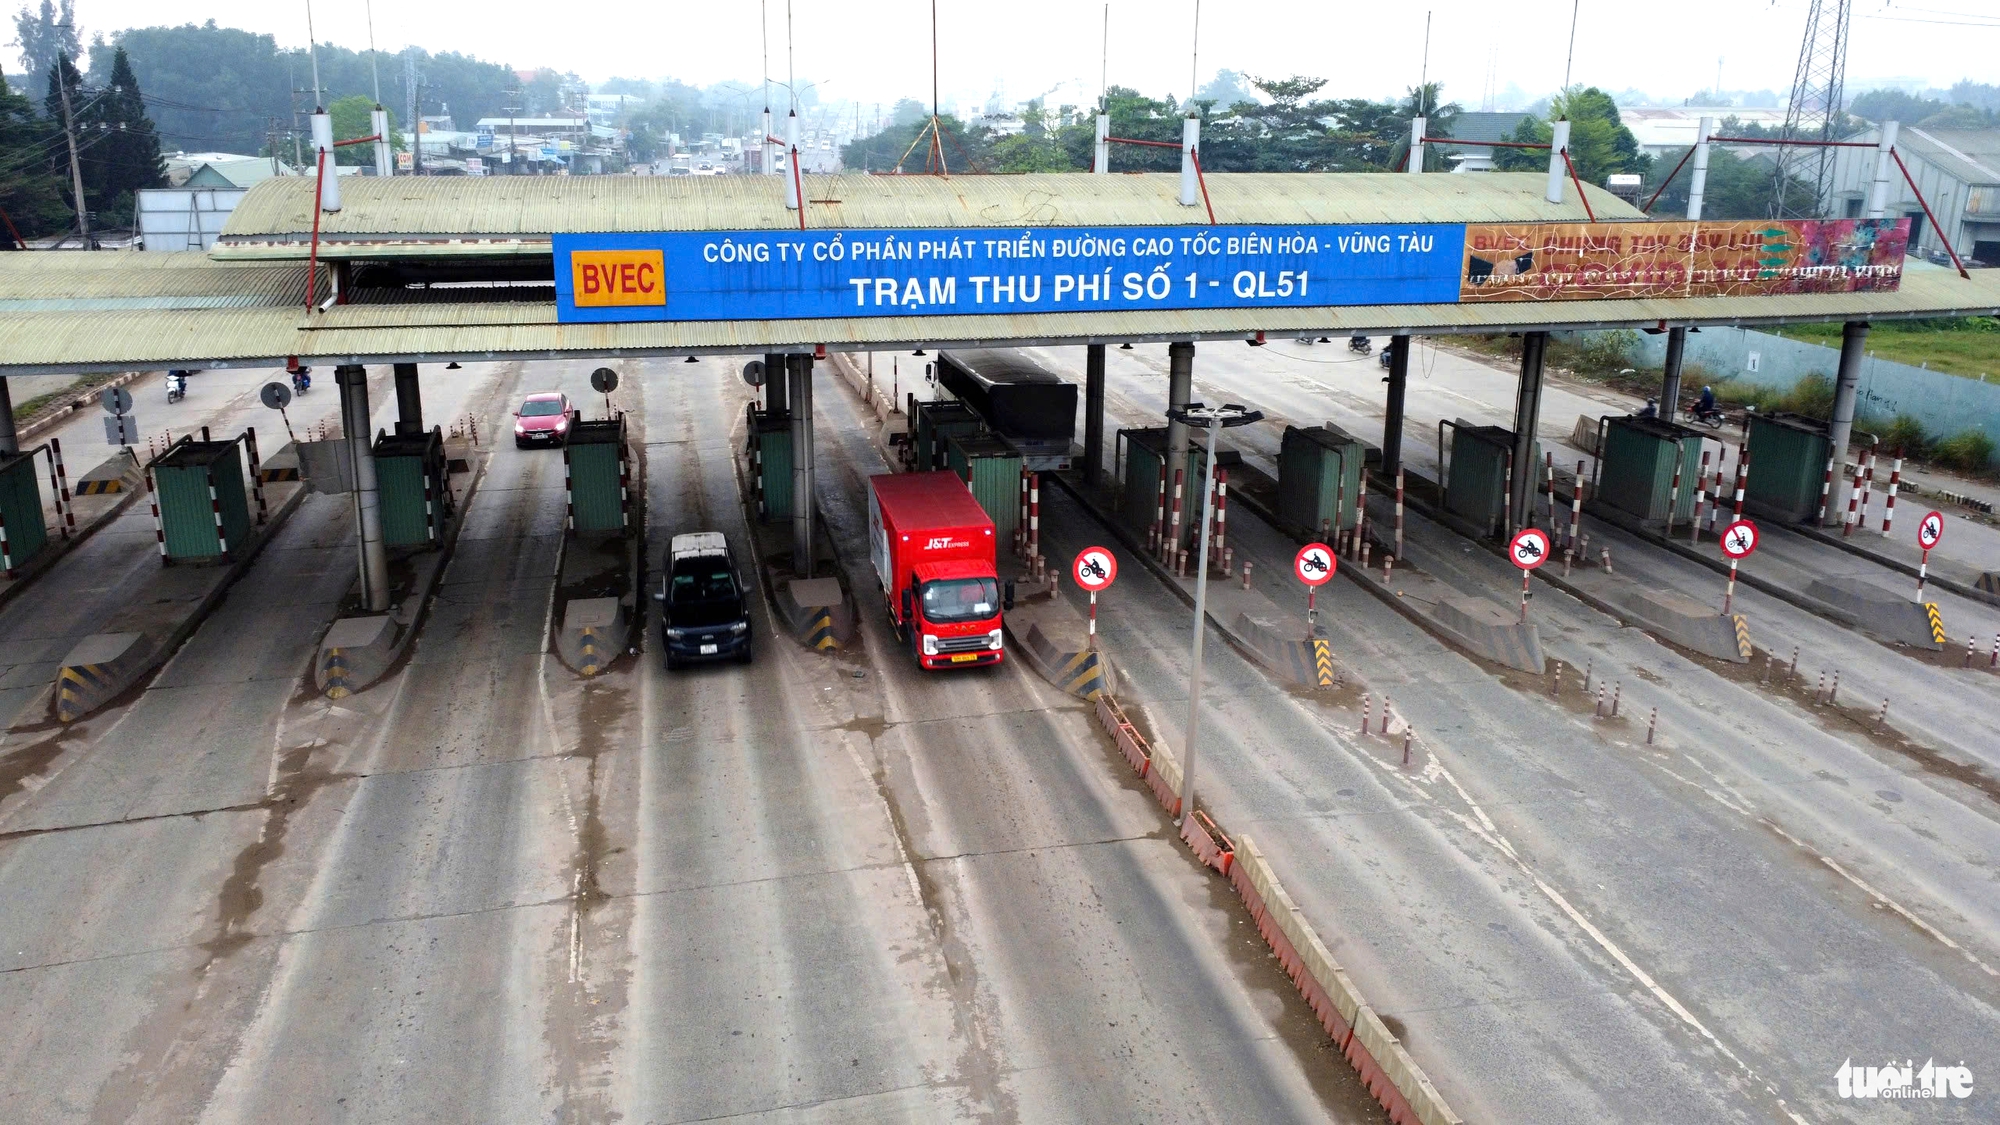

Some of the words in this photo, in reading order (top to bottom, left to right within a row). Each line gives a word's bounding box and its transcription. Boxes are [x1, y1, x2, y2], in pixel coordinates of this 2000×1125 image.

[703, 239, 769, 262] CÔNG
[778, 243, 806, 262] TY
[813, 233, 845, 261] CỔ
[852, 235, 912, 260] PHẦN
[919, 236, 976, 260] PHÁT
[984, 231, 1046, 259] TRIỂN
[1052, 232, 1126, 258] ĐƯỜNG
[1134, 238, 1174, 257] CAO
[1180, 231, 1221, 256] TỐC
[1228, 232, 1272, 255] BIÊN
[1279, 231, 1319, 254] HÒA
[1338, 232, 1391, 254] VŨNG
[1398, 231, 1434, 253] TÀU
[1474, 235, 1530, 250] BVEC
[582, 262, 655, 294] BVEC
[850, 277, 956, 309] TRẠM
[969, 275, 1041, 304] THU
[1054, 267, 1111, 302] PHÍ
[1122, 262, 1172, 301] SỐ
[1185, 272, 1198, 299] 1
[1233, 270, 1309, 298] QL51
[924, 537, 953, 550] J&T
[948, 541, 969, 549] EXPRESS
